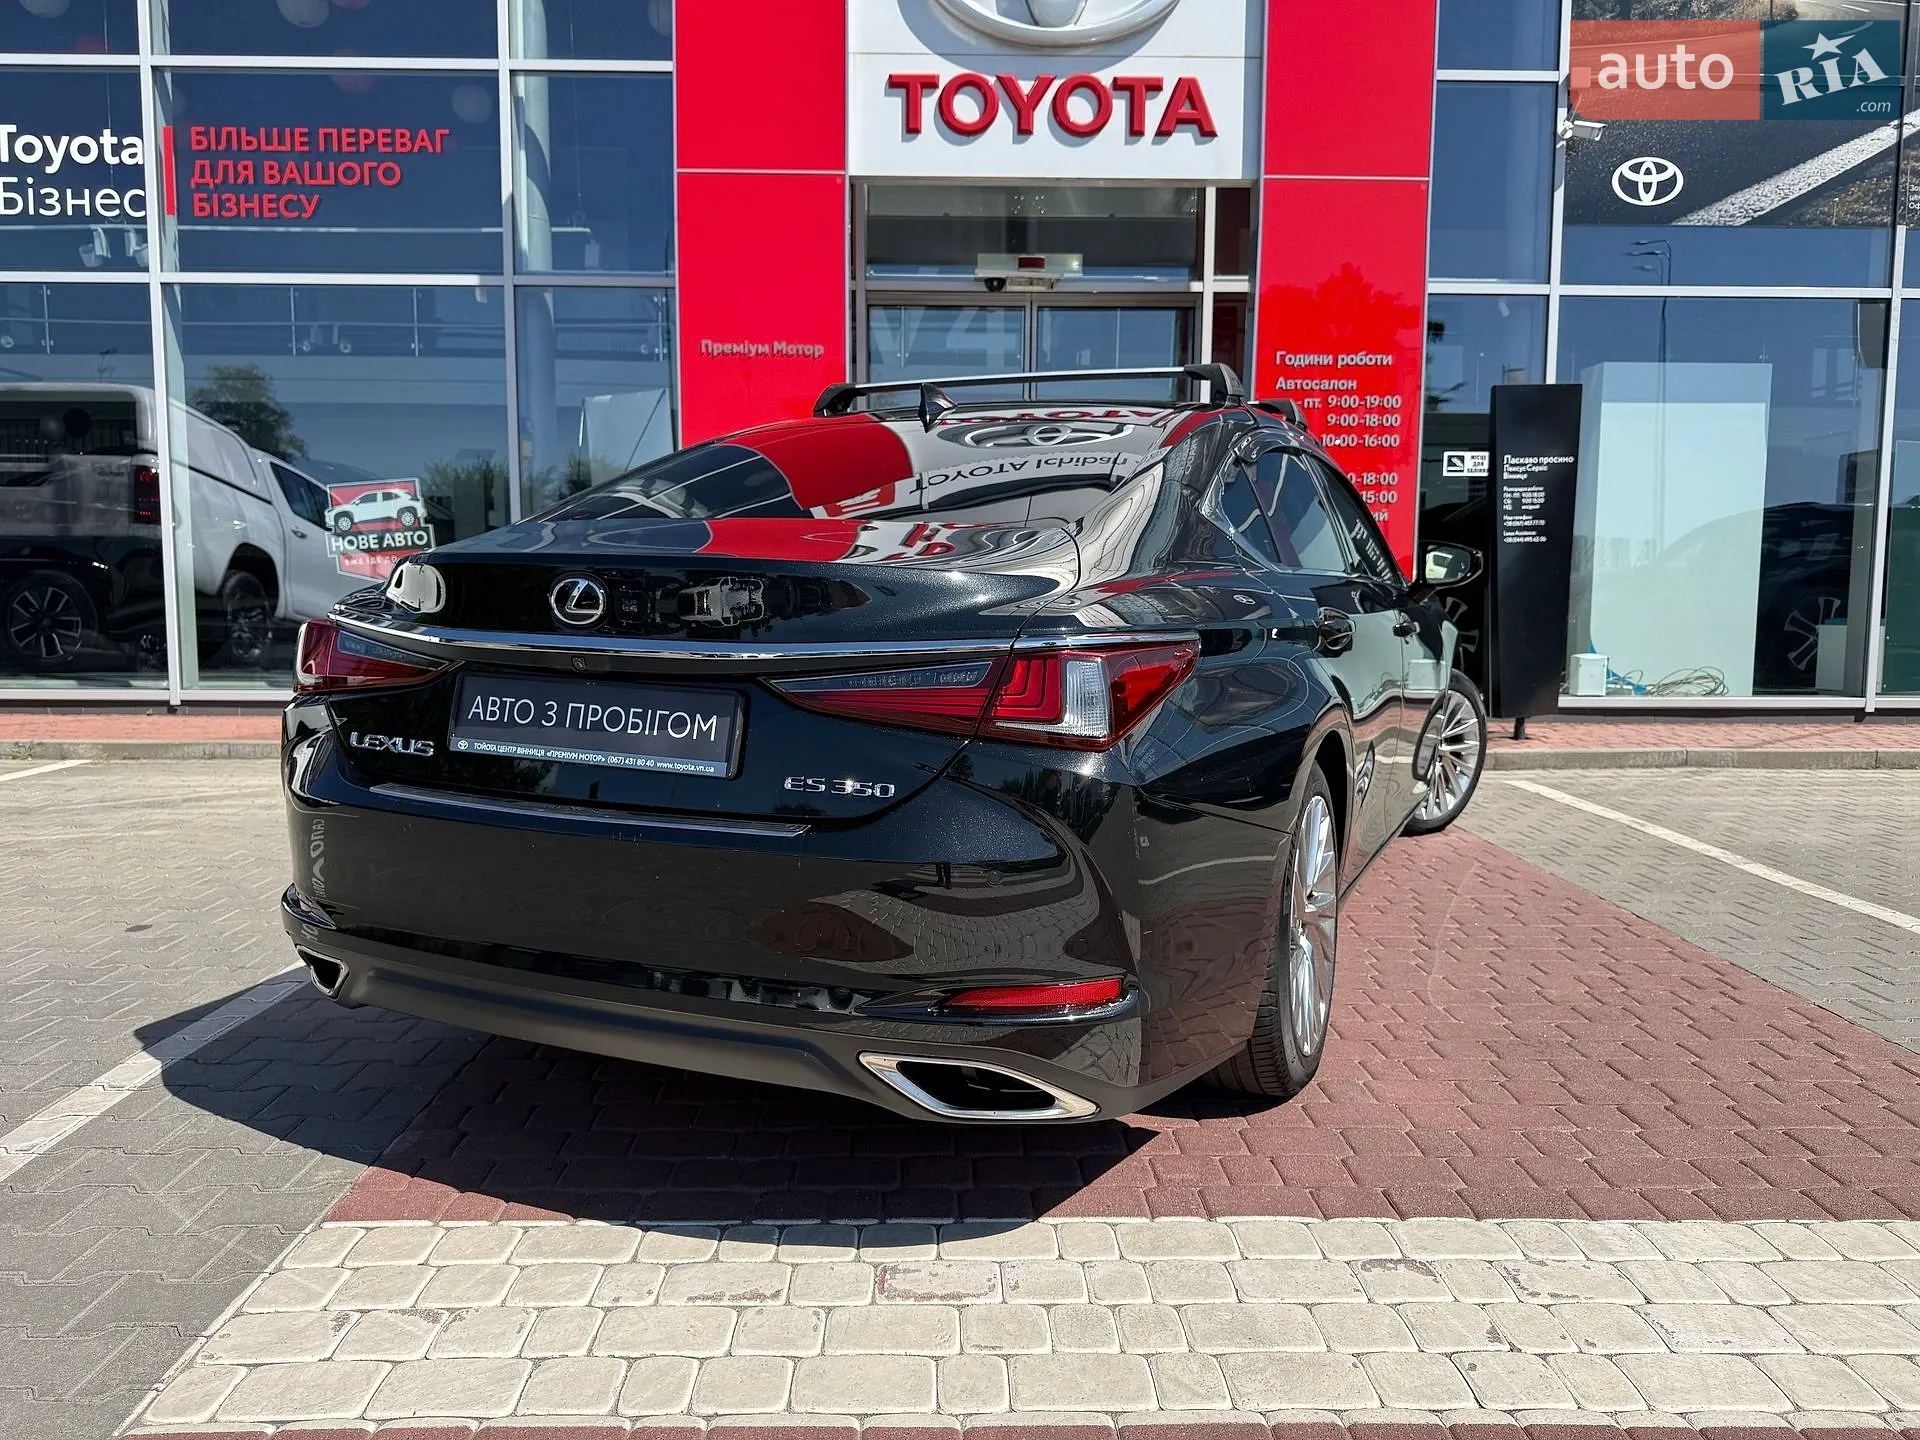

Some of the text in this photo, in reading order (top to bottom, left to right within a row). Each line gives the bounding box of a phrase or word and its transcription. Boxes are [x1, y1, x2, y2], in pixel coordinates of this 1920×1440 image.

[888, 72, 1217, 138] TOYOTA
[0, 124, 144, 174] Toyota
[190, 126, 449, 153] БІЛЬШЕ ПЕРЕВАГ
[190, 160, 402, 188] ДЛЯ ВАШОГО
[0, 177, 145, 217] Бізнес
[193, 193, 319, 218] БІЗНЕСУ
[700, 339, 825, 358] Преміум Мотор
[1275, 351, 1393, 368] Години роботи
[1275, 376, 1357, 390] Автосалон
[1327, 395, 1402, 409] 9:00-19:00
[1327, 413, 1401, 428] 9:00-18:00
[331, 530, 428, 551] НОВЕ АВТО
[468, 695, 718, 742] АВТО З ПРОБІГОМ
[350, 731, 434, 757] LEXUS
[474, 742, 497, 752] ТОЙОТА
[497, 744, 516, 753] ЦЕНТР
[656, 761, 715, 773] www.toyota.vn.ua
[784, 776, 896, 798] ES 350
